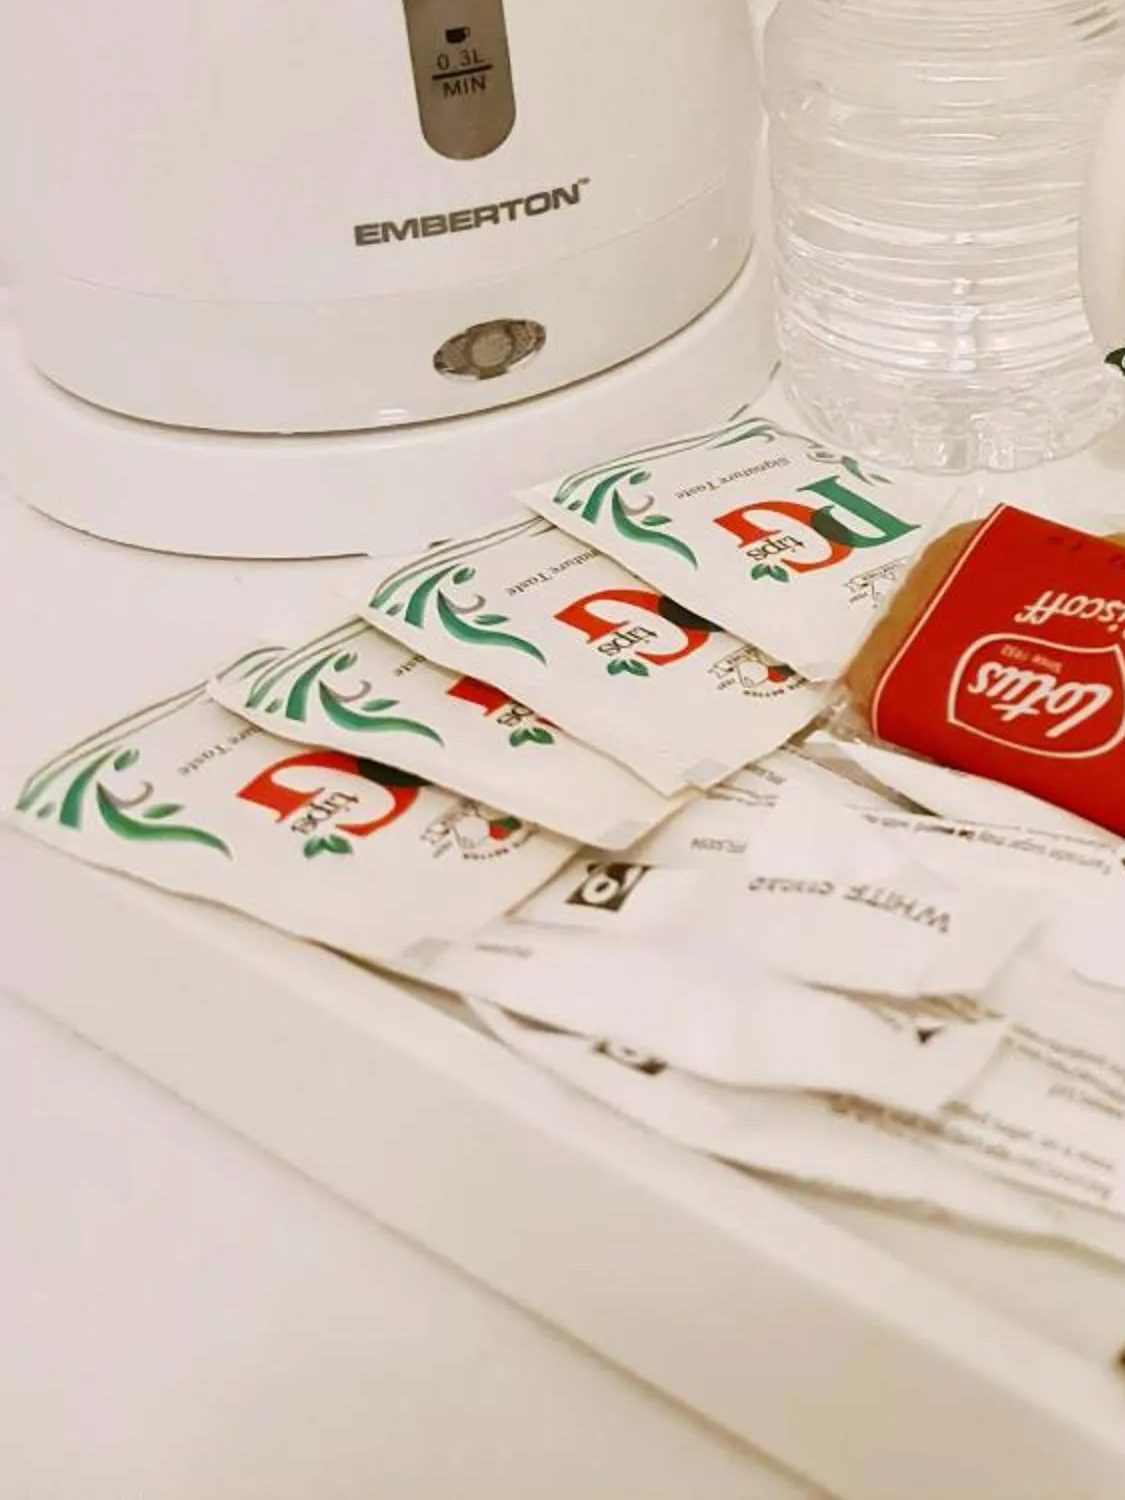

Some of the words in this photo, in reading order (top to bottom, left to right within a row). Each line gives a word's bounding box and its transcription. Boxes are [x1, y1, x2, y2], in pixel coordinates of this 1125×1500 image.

[442, 75, 487, 99] MIN
[354, 183, 580, 246] EMBERTON
[673, 478, 720, 501] Taste
[720, 455, 791, 493] Signature
[713, 475, 921, 573] PG
[745, 533, 804, 562] tips
[553, 588, 726, 667] G
[598, 626, 659, 657] tips
[966, 659, 1115, 739] Lotus
[236, 750, 434, 837] G
[291, 789, 360, 835] tips
